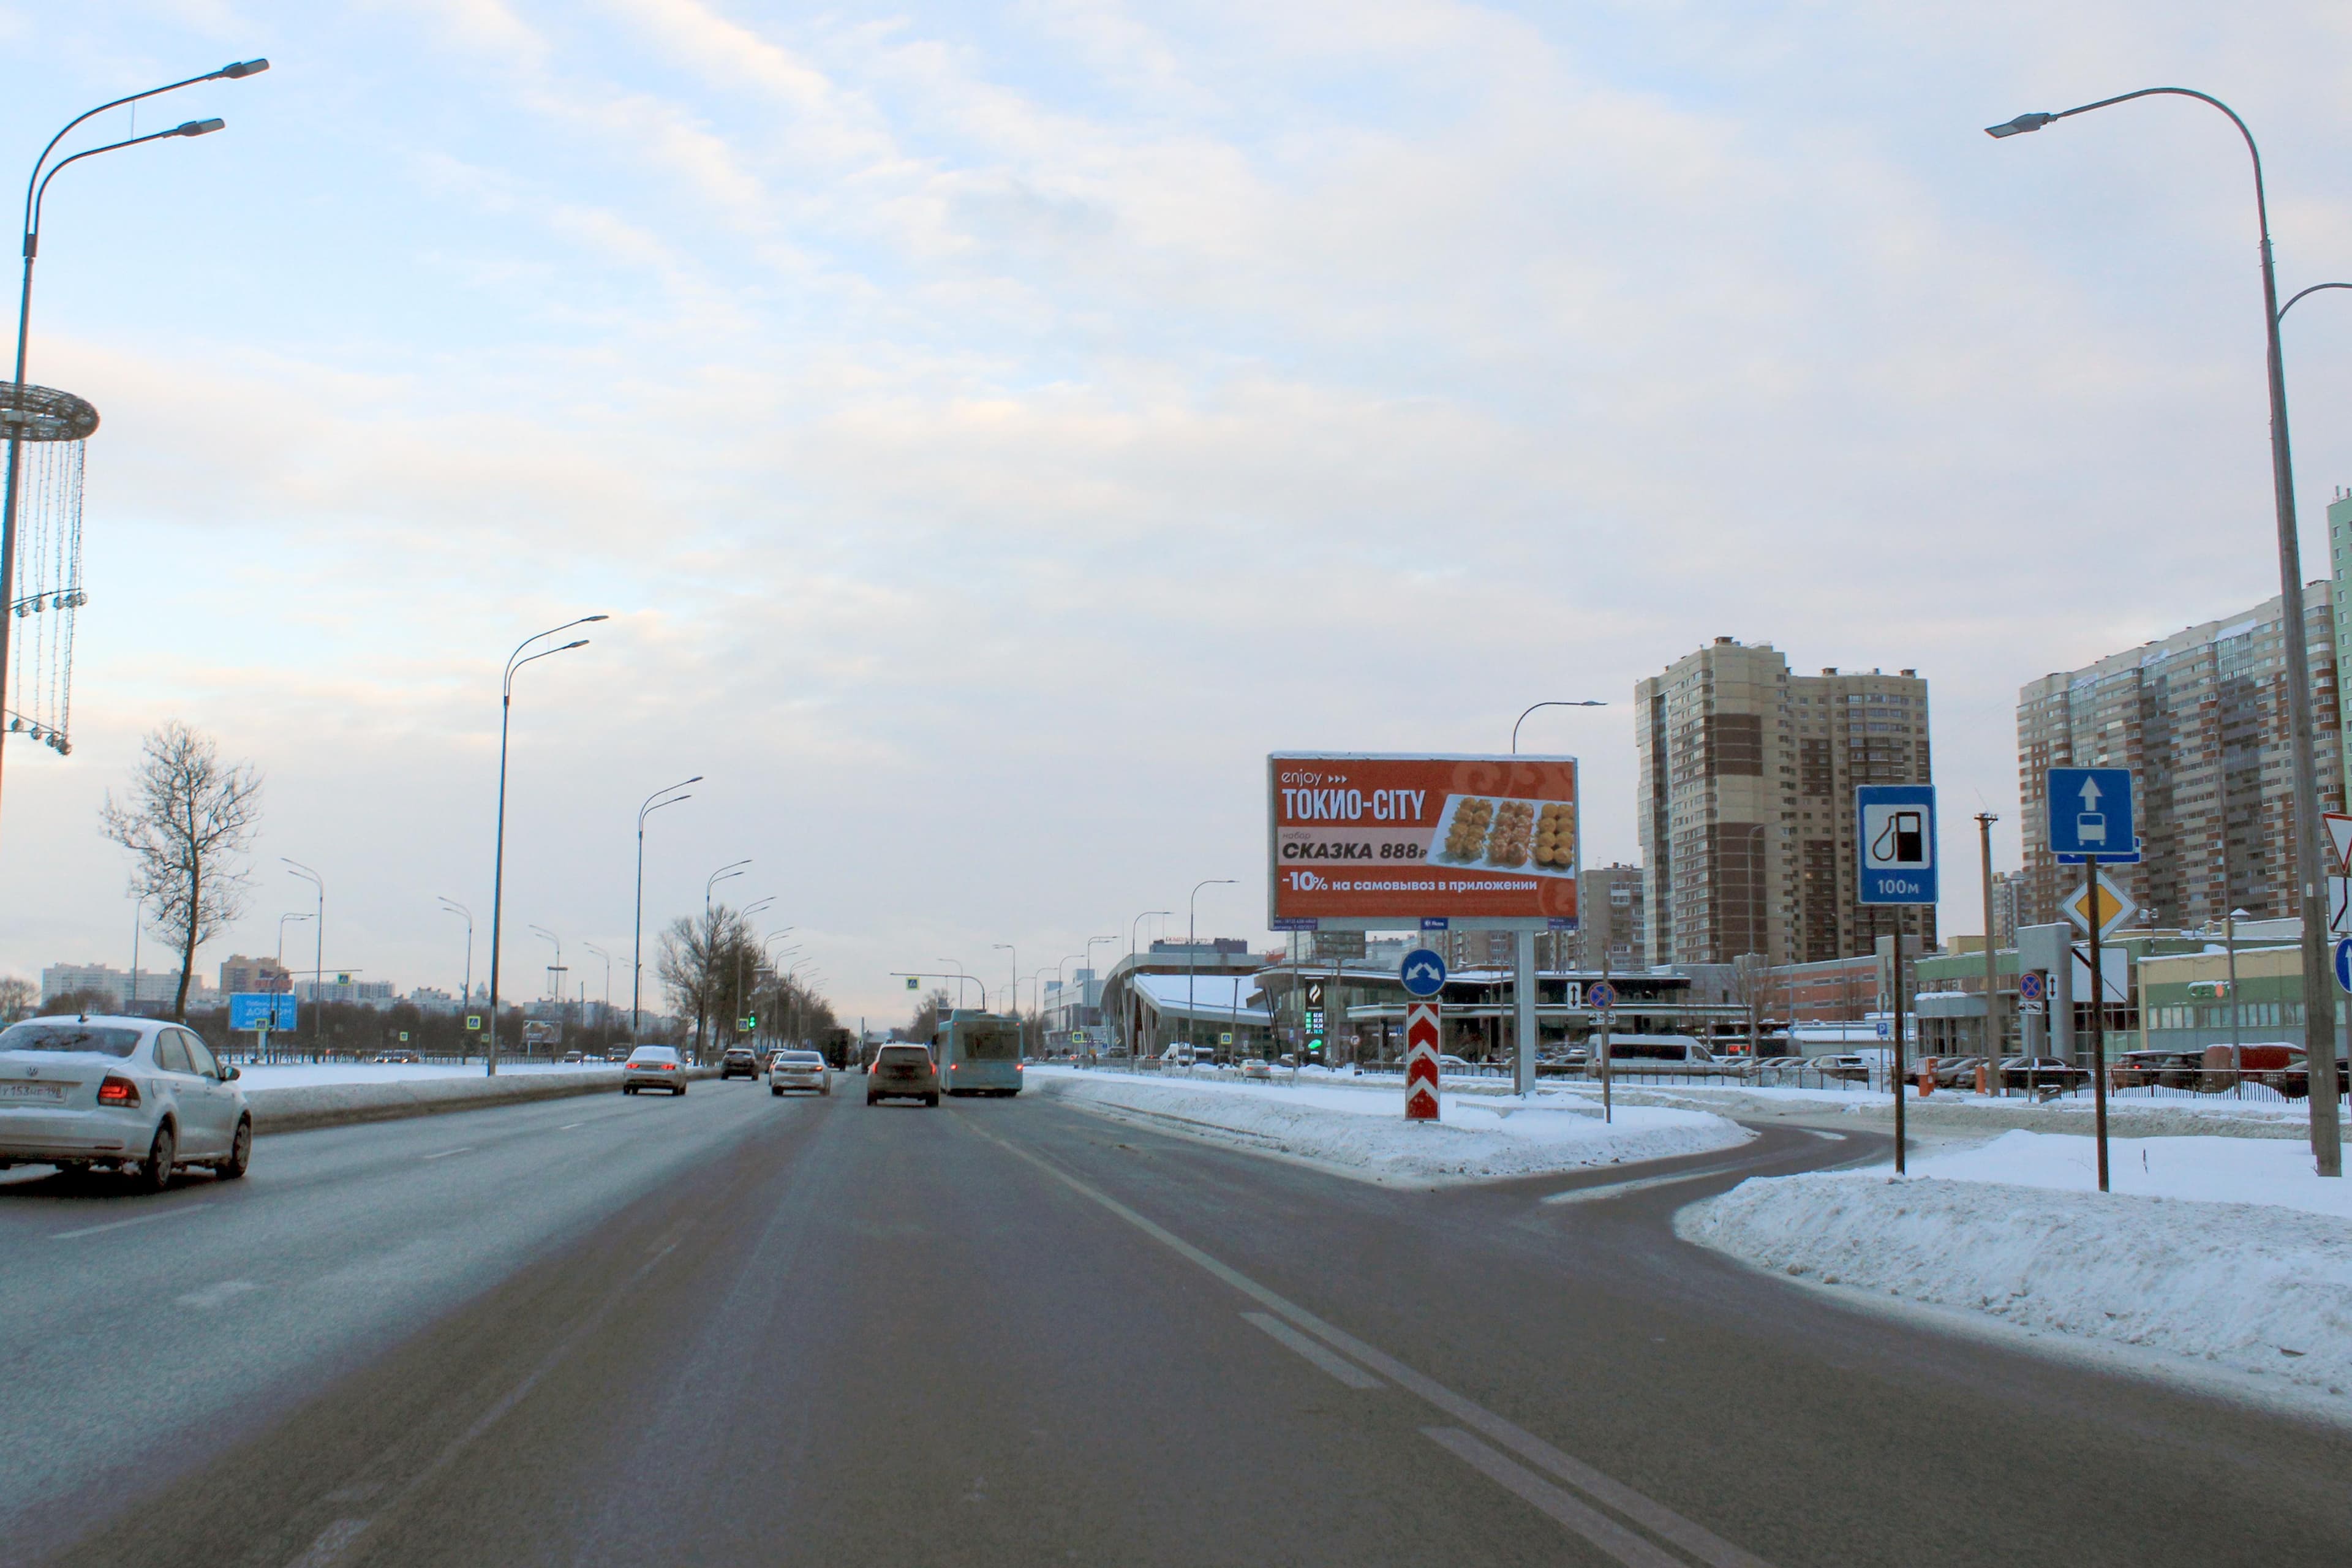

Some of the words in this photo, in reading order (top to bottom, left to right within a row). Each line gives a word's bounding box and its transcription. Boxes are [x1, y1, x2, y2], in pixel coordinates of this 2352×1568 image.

[1281, 768, 1322, 786] enjoy
[1282, 788, 1426, 820] ТОКИО-CITY
[1283, 831, 1311, 840] набор
[1283, 842, 1373, 859] СКАЗКА
[1282, 871, 1328, 891] -10%
[1332, 881, 1351, 891] на
[1353, 881, 1435, 891] самовывоз
[1438, 881, 1446, 891] в
[1449, 881, 1537, 894] приложении
[246, 1008, 292, 1017] ДОБМ
